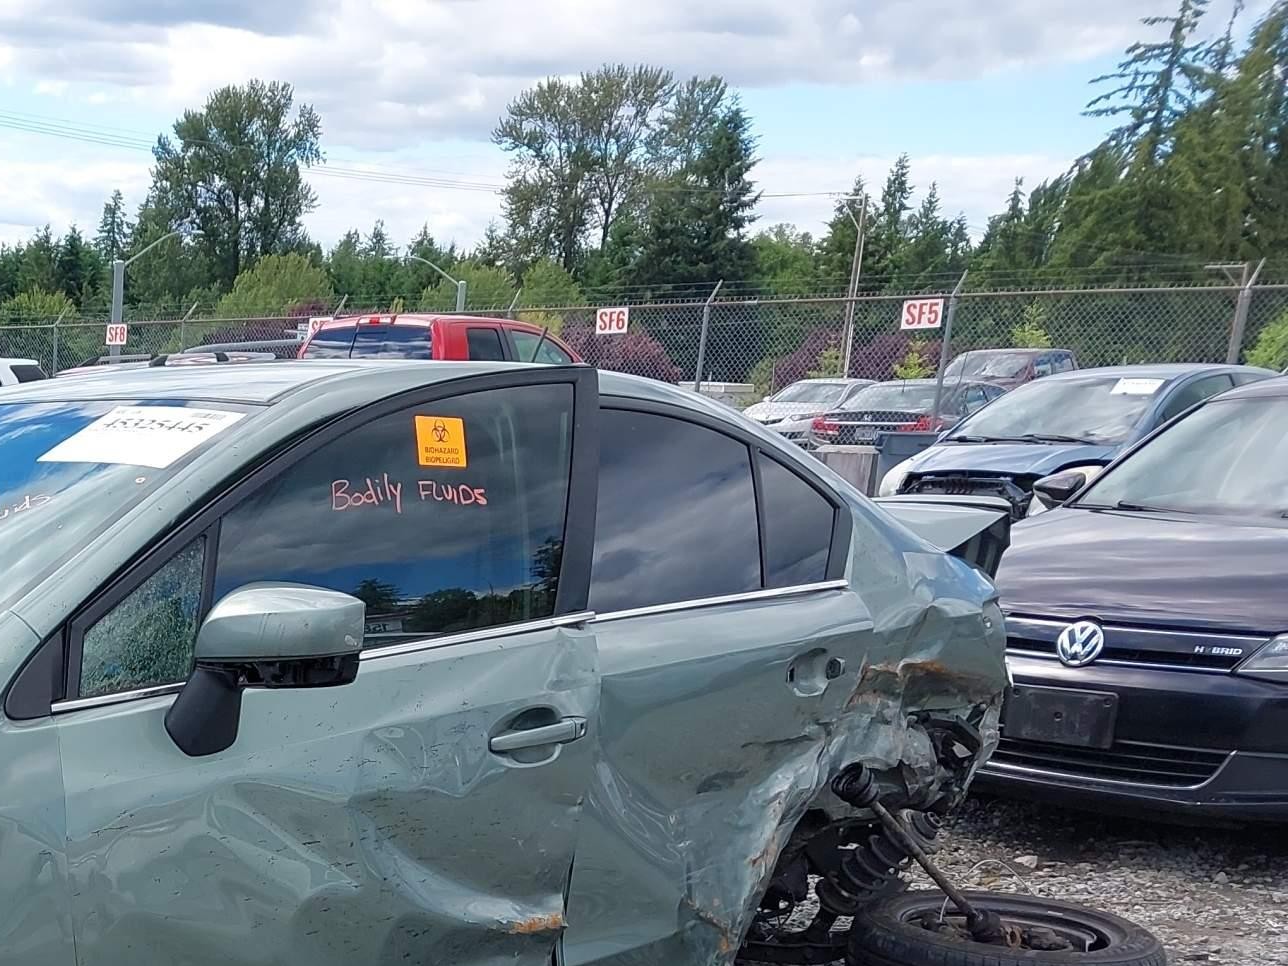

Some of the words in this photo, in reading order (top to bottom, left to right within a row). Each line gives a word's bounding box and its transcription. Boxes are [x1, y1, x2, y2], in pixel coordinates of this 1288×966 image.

[598, 311, 627, 331] SF6
[905, 301, 940, 326] SF5
[107, 325, 126, 343] SF8
[424, 446, 460, 455] BIOHAZARD
[332, 473, 402, 513] Bodily
[418, 480, 488, 505] FLUIDS
[1194, 645, 1243, 655] HBRID
